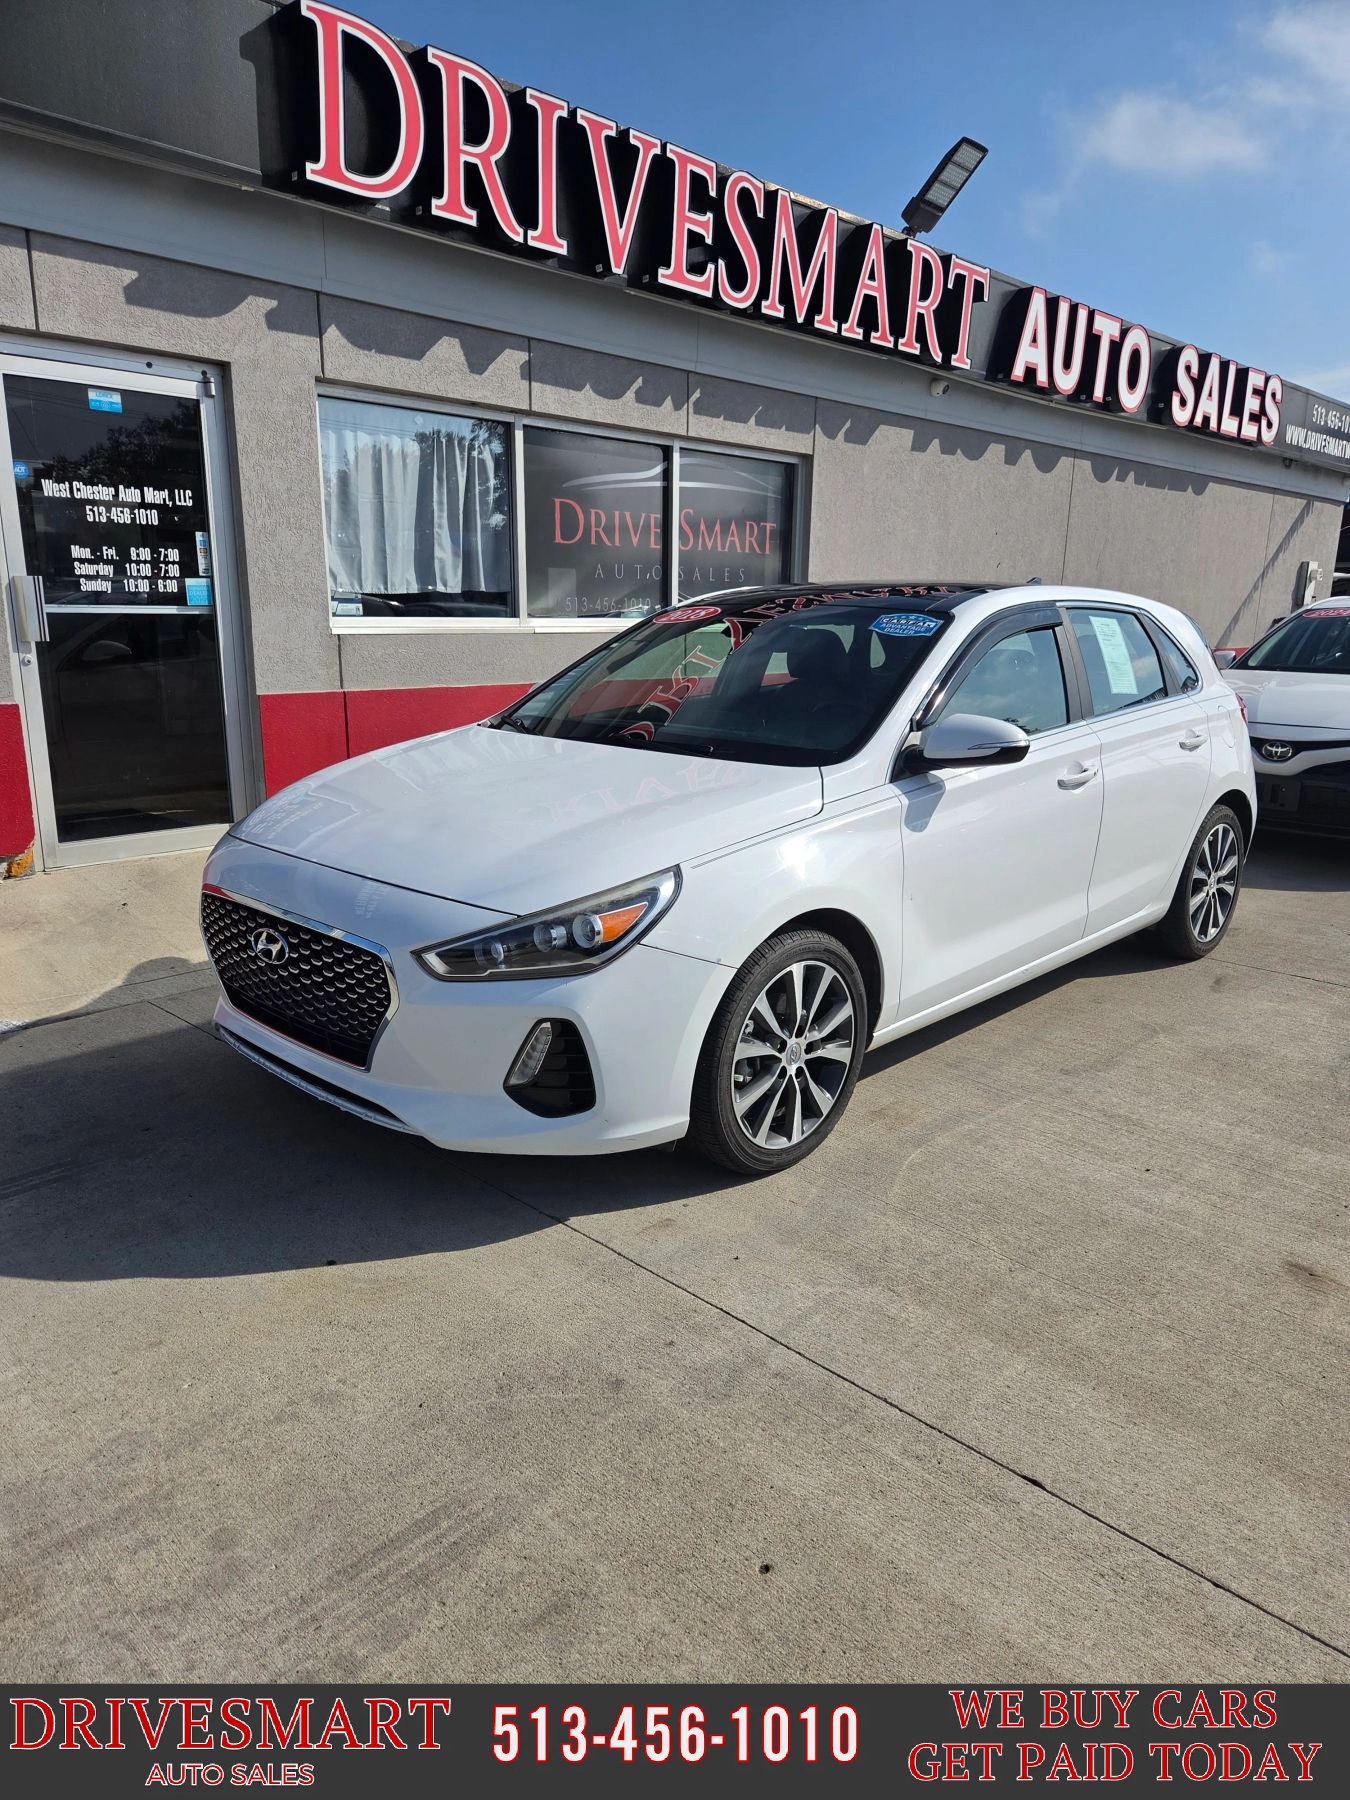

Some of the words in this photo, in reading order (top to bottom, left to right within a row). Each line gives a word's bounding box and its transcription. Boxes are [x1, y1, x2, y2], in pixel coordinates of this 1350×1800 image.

[301, 0, 990, 369] DRIVESMART
[1010, 286, 1150, 413] AUTO
[1172, 344, 1283, 446] SALES
[41, 478, 71, 498] West
[72, 481, 115, 501] Chester
[118, 485, 141, 503] Auto
[144, 486, 173, 507] Mart,
[175, 489, 193, 507] LLC
[86, 505, 159, 526] 513-456-1010
[71, 545, 94, 559] Mon.
[102, 546, 119, 560] Fri.
[130, 547, 151, 561] 9:00
[159, 548, 180, 561] 7:00
[74, 561, 114, 577] Saturday
[125, 563, 152, 577] 10:00
[159, 564, 180, 577] 7:00
[595, 564, 662, 580] AUTO
[678, 566, 745, 582] SALES
[80, 578, 112, 593] Sunday
[123, 578, 150, 592] 10:00
[157, 579, 178, 592] 6:00
[657, 608, 715, 621] 2018
[881, 617, 937, 628] CARFAX
[880, 623, 928, 632] ADVANTAGE
